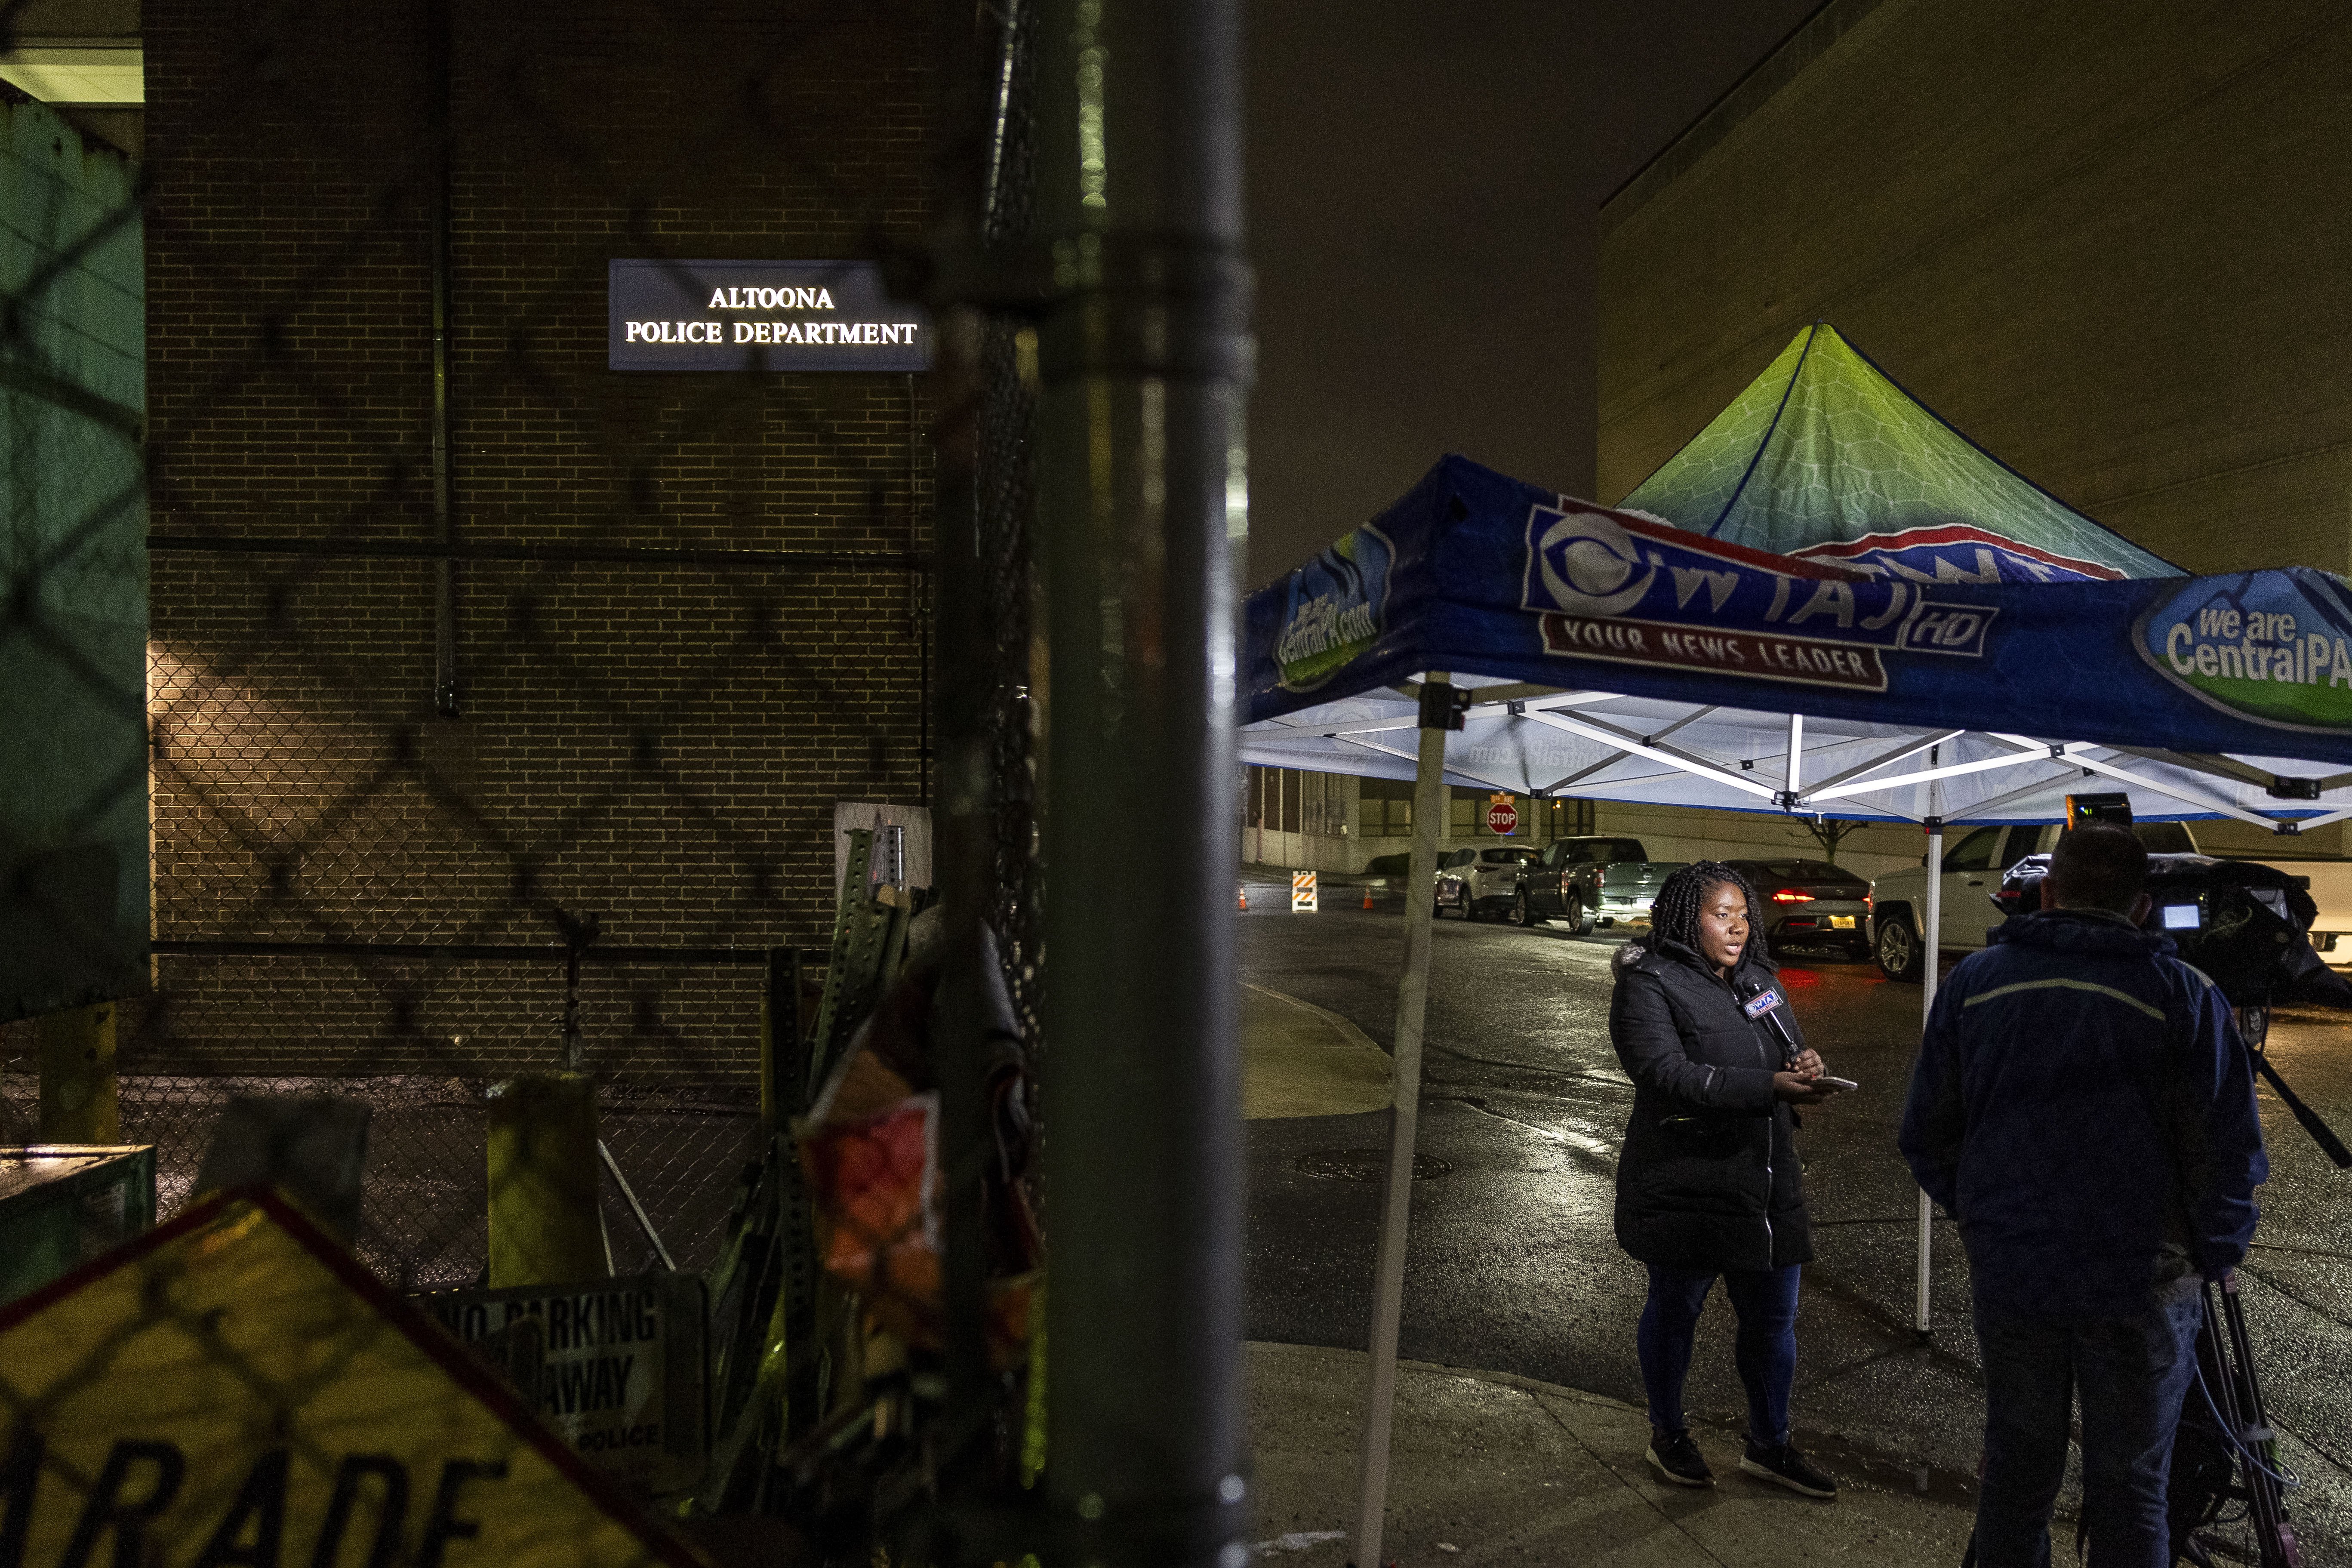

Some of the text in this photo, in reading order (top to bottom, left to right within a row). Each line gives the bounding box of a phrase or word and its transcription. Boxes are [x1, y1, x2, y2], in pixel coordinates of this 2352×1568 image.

[708, 287, 834, 309] ALTOONA
[625, 321, 917, 344] POLICE DEPARTMENT
[1912, 612, 1981, 645] HD
[2199, 608, 2296, 643] we are
[1564, 619, 1869, 679] YOUR NEWS LEADER
[1490, 812, 1515, 825] STOP
[1754, 991, 1776, 1008] WTAJ
[579, 1424, 659, 1452] POLICE
